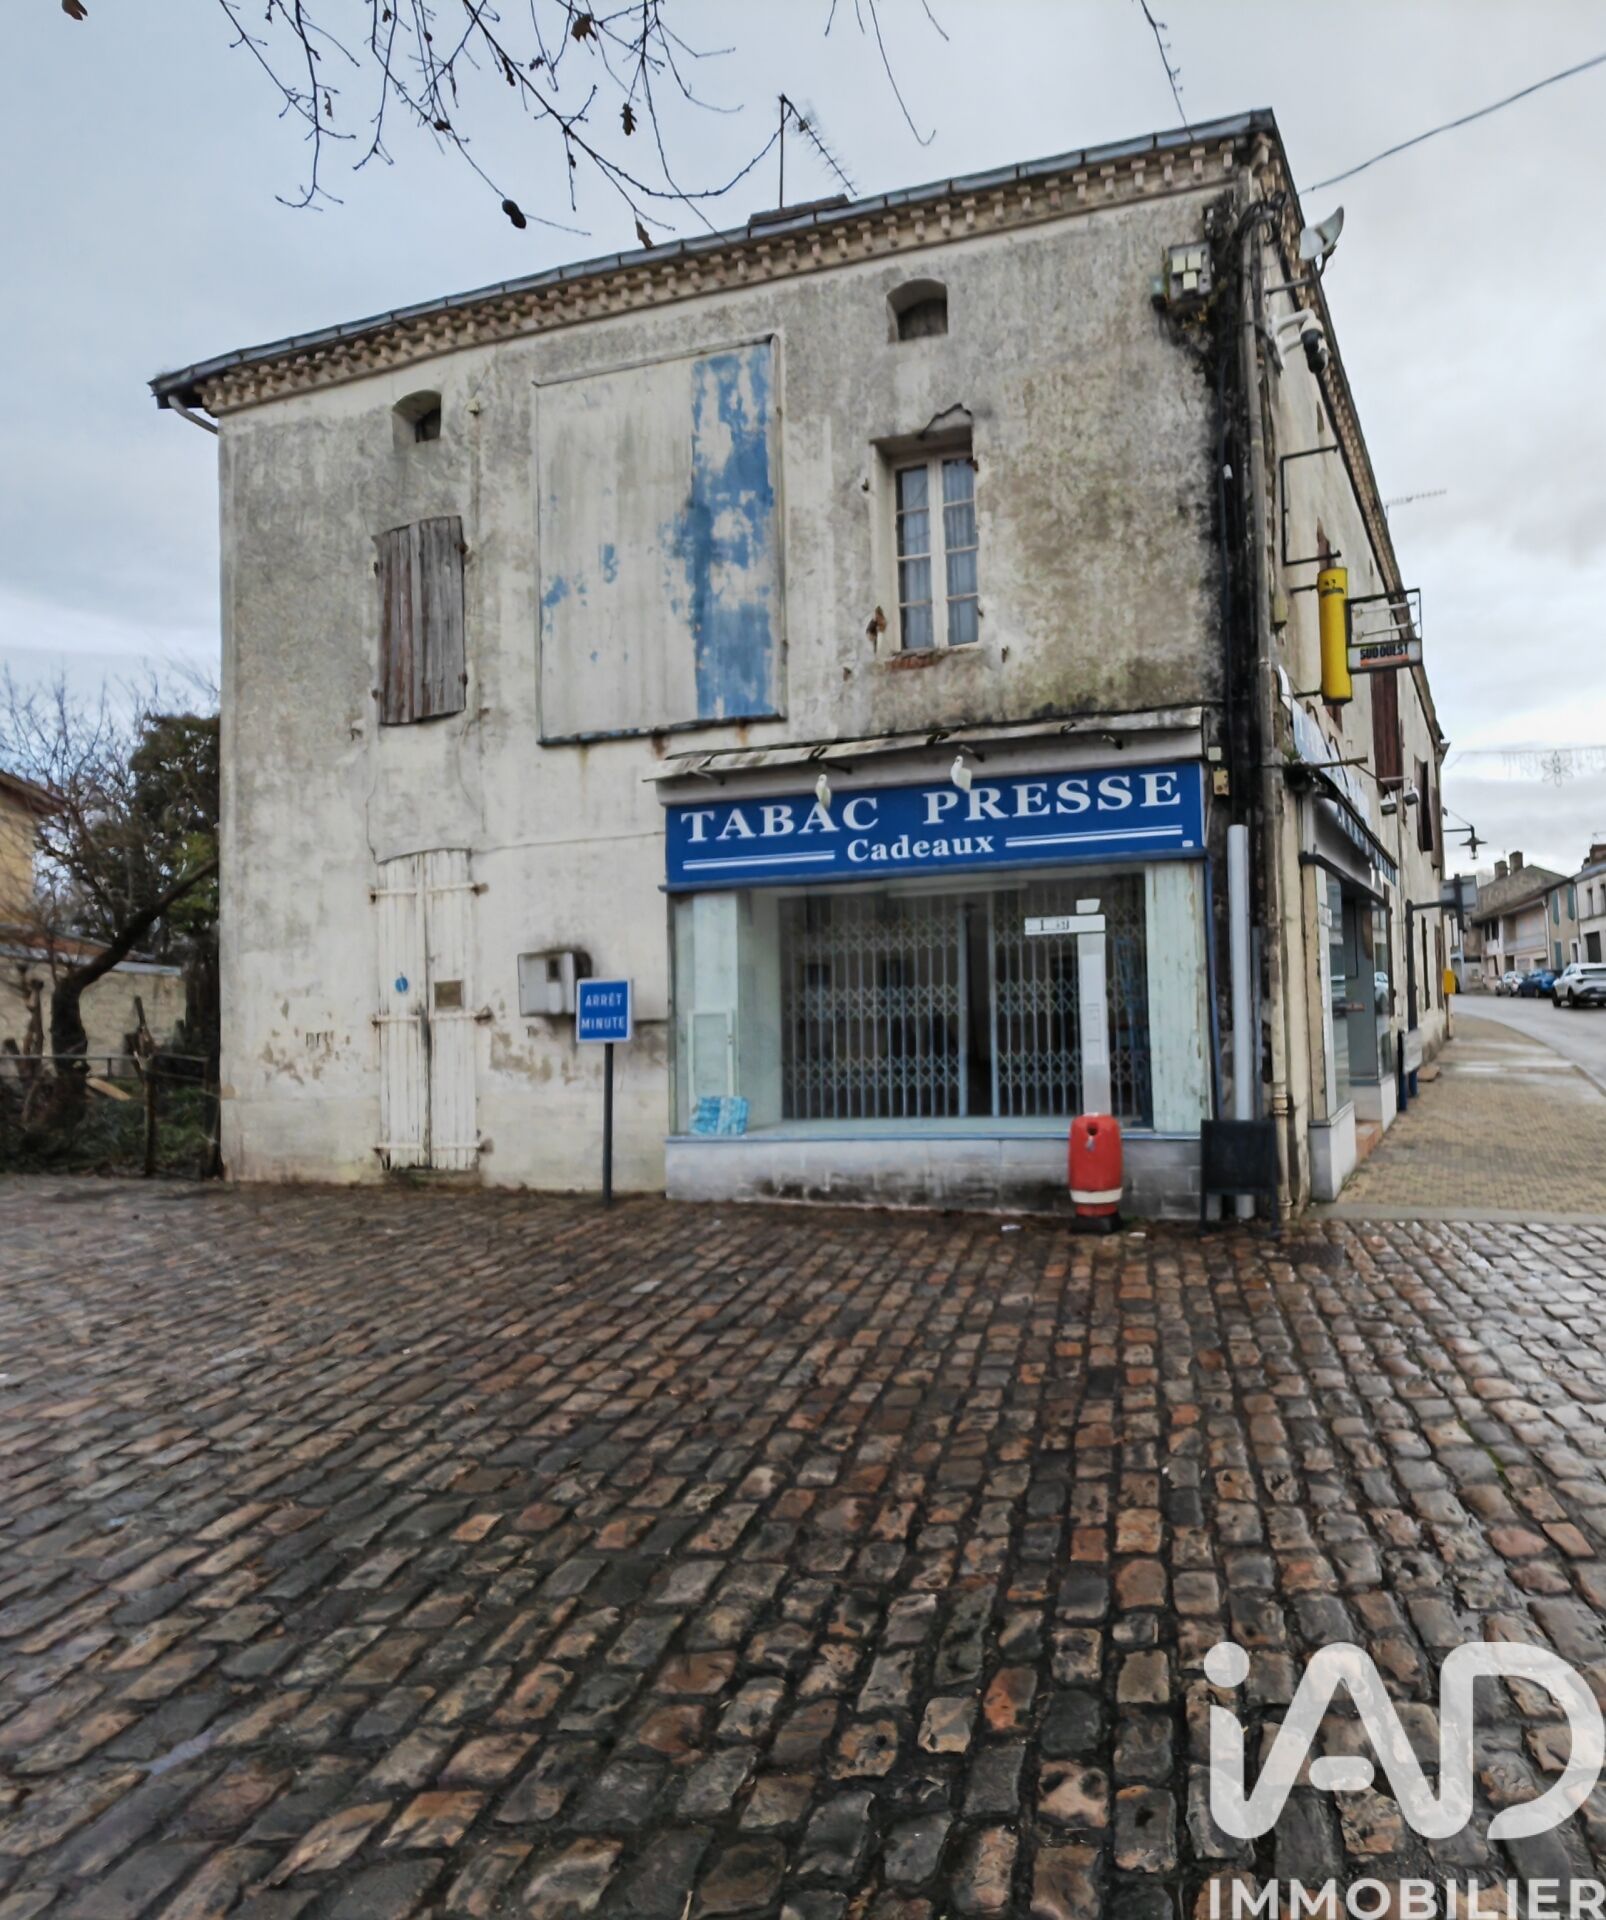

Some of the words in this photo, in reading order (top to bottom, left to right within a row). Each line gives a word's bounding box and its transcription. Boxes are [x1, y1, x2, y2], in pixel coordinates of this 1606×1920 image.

[681, 797, 880, 843] TABAC
[923, 771, 1182, 825] PRESSE
[847, 834, 995, 863] Cadeaux
[581, 1015, 626, 1030] MINUTE
